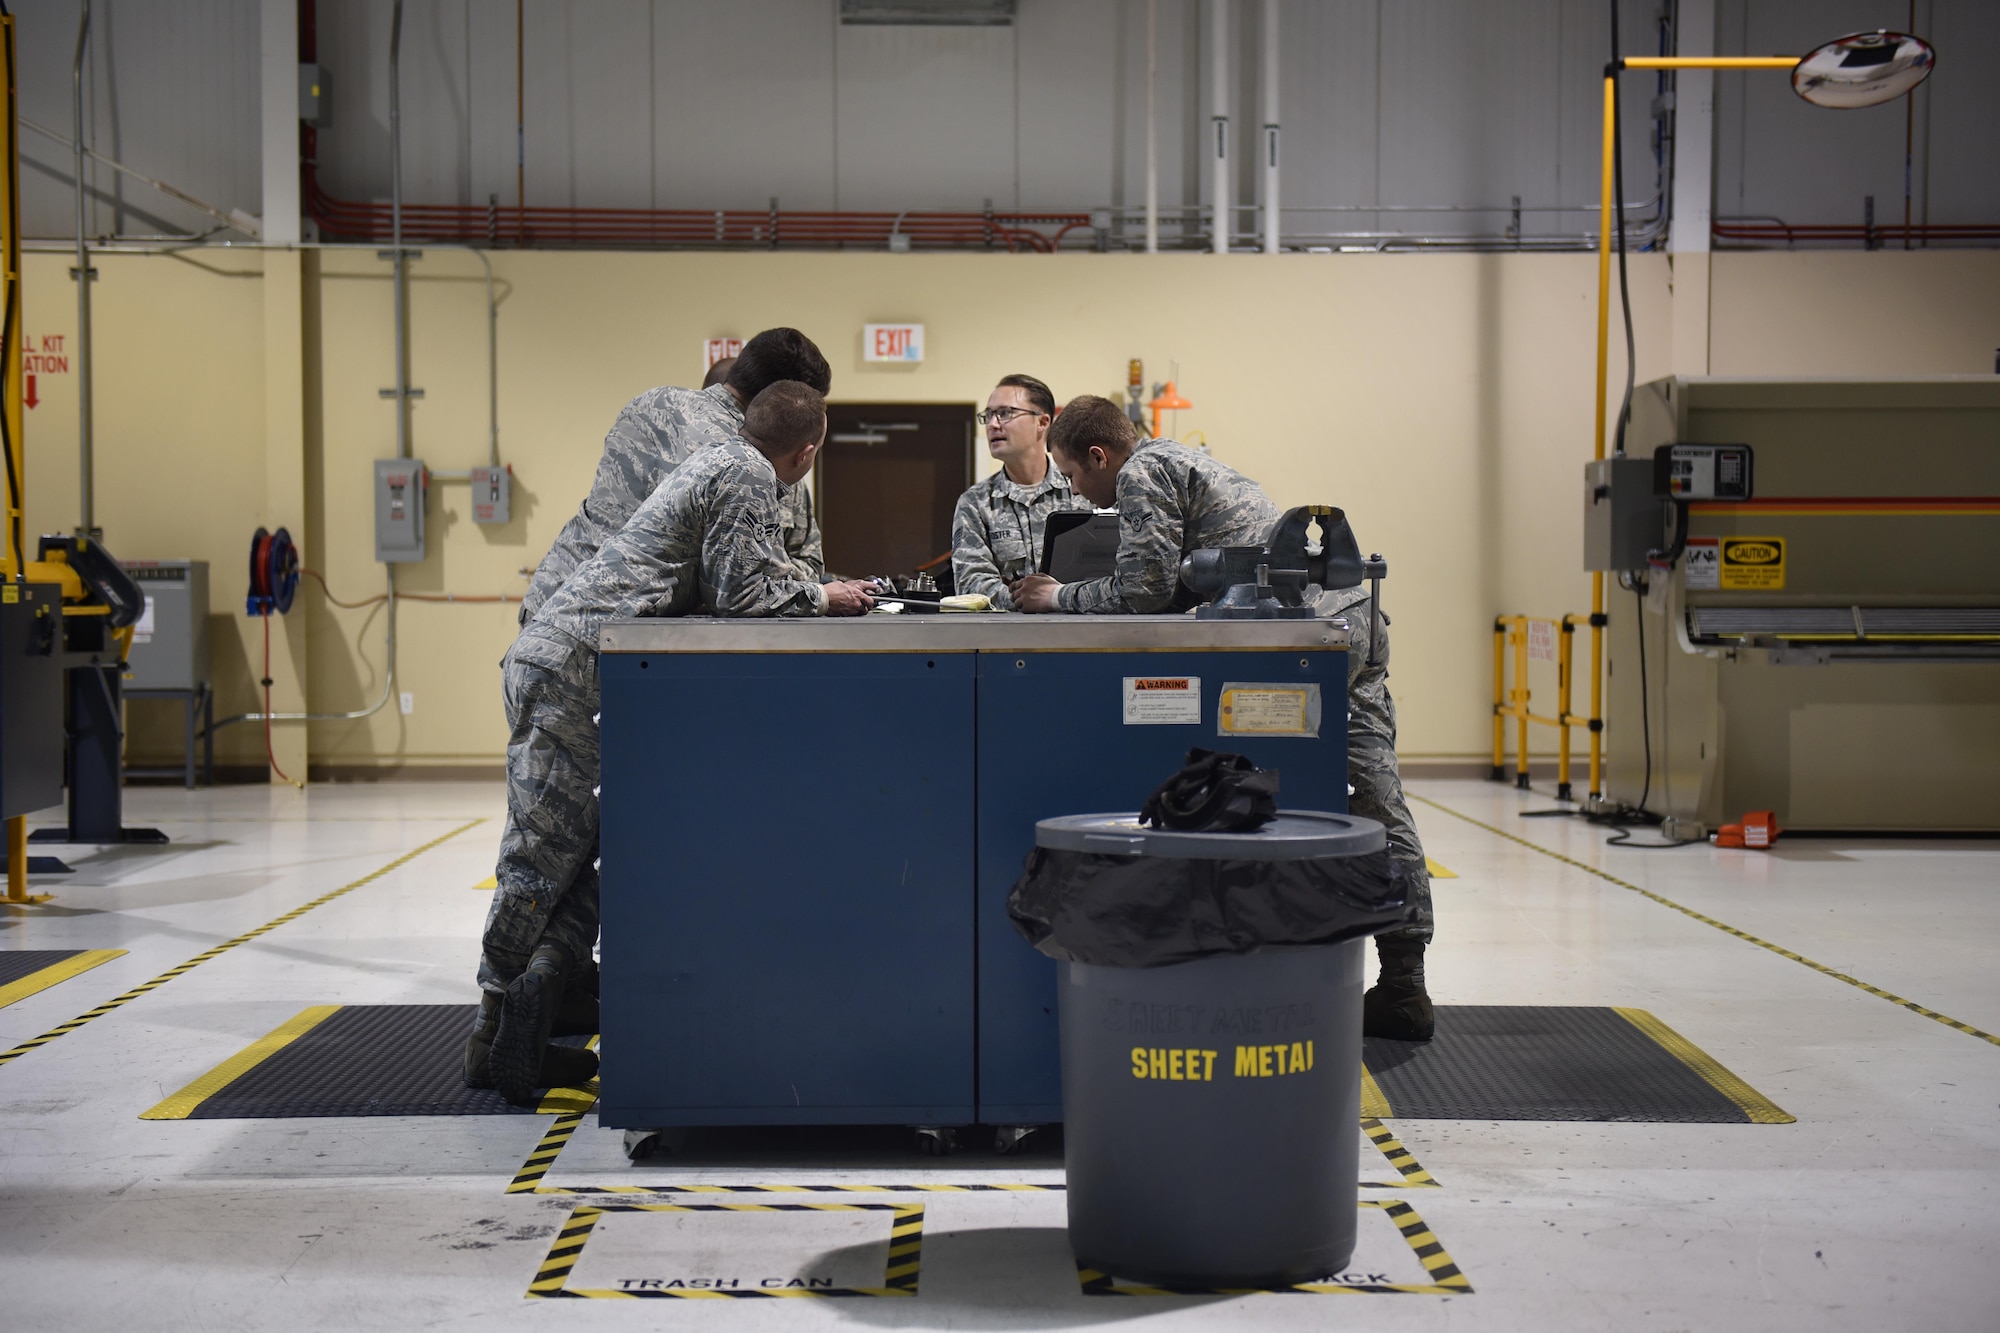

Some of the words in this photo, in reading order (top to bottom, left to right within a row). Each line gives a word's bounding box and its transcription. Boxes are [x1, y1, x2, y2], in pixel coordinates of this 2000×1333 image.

[42, 335, 65, 352] KIT
[875, 329, 913, 357] EXIT
[24, 355, 69, 374] ATION
[1734, 547, 1772, 560] CAUTION
[1147, 681, 1187, 689] WARNING
[1131, 1047, 1218, 1082] SHEET
[617, 1279, 739, 1288] TRASH
[760, 1278, 833, 1288] CAN
[1314, 1273, 1393, 1284] ACK
